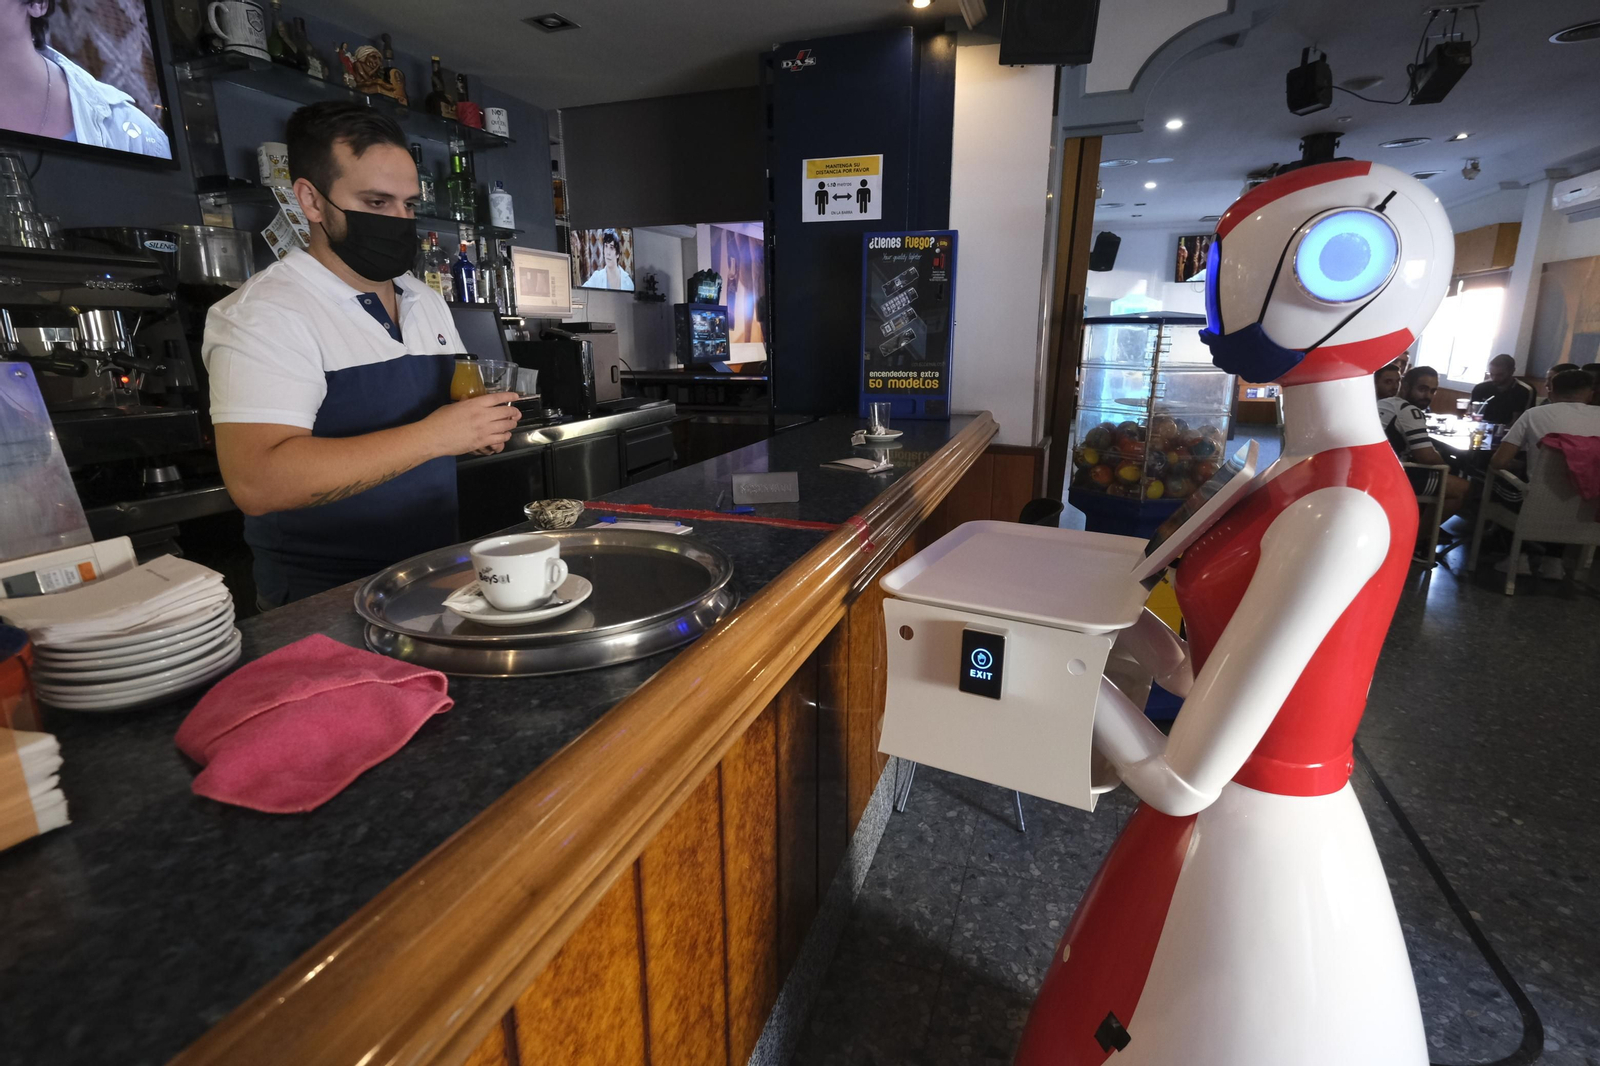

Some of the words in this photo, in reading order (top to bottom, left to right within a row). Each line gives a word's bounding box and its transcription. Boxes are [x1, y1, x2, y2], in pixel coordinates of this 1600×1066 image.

[781, 57, 817, 69] DAS
[905, 236, 935, 250] fuego?
[869, 370, 918, 378] encendedores
[920, 370, 940, 378] extra
[869, 378, 883, 388] 50
[888, 377, 940, 389] modelos
[969, 668, 993, 681] EXIT
